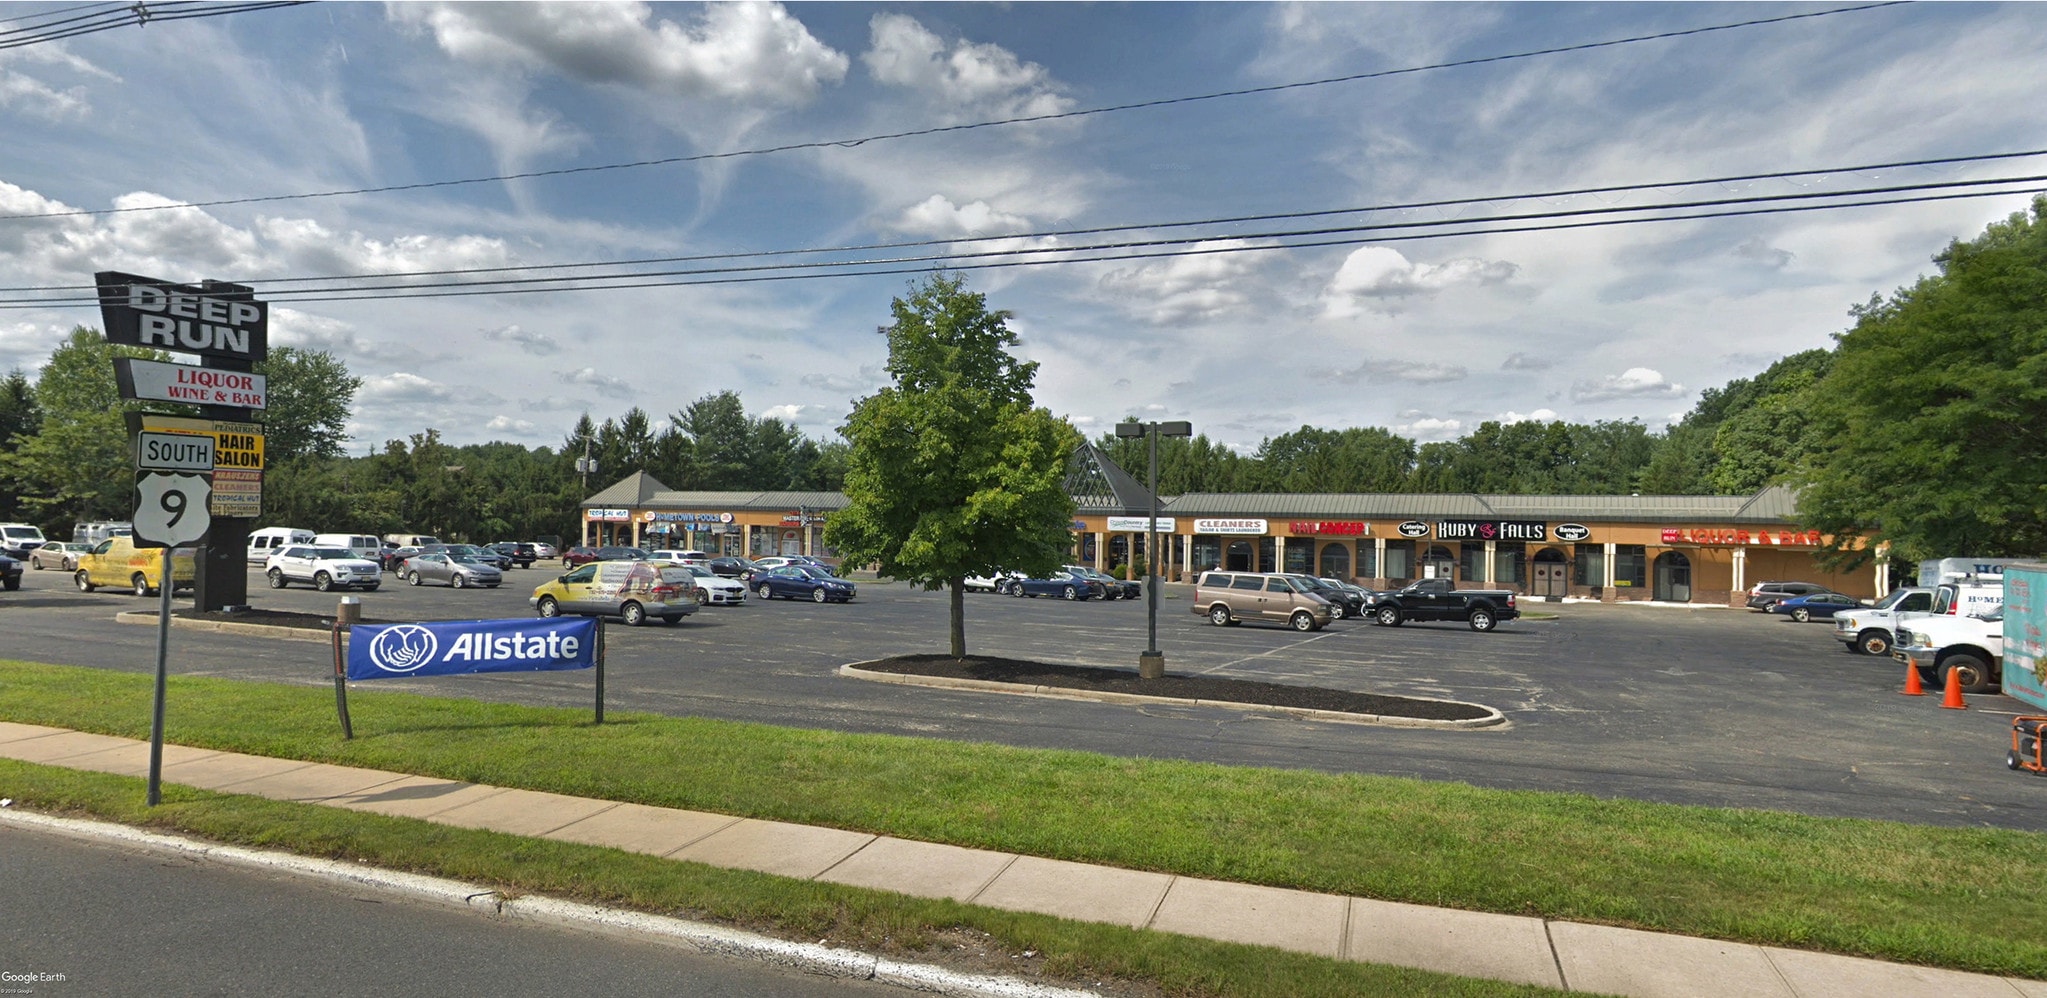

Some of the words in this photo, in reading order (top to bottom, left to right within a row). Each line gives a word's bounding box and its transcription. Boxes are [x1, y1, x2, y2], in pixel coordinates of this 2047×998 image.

[128, 284, 261, 326] DEEP
[139, 313, 250, 354] RUN
[176, 368, 254, 391] LIQUOR
[167, 385, 209, 401] WINE
[214, 391, 228, 402] &
[232, 392, 262, 406] BAR
[214, 424, 261, 434] PEDIATRICS
[219, 433, 255, 451] HAIR
[147, 439, 208, 464] SOUTH
[214, 450, 260, 468] SALON
[213, 482, 260, 491] CLEANERS
[160, 489, 187, 529] 9
[1199, 520, 1262, 528] CLEANERS
[1289, 521, 1319, 535] NAIL
[1319, 521, 1371, 536] CONCEPT
[1500, 522, 1544, 540] FALLS
[1678, 528, 1750, 545] LIQUOR
[1758, 529, 1773, 545] &
[1968, 595, 2003, 604] HOME
[442, 630, 580, 662] Allstate
